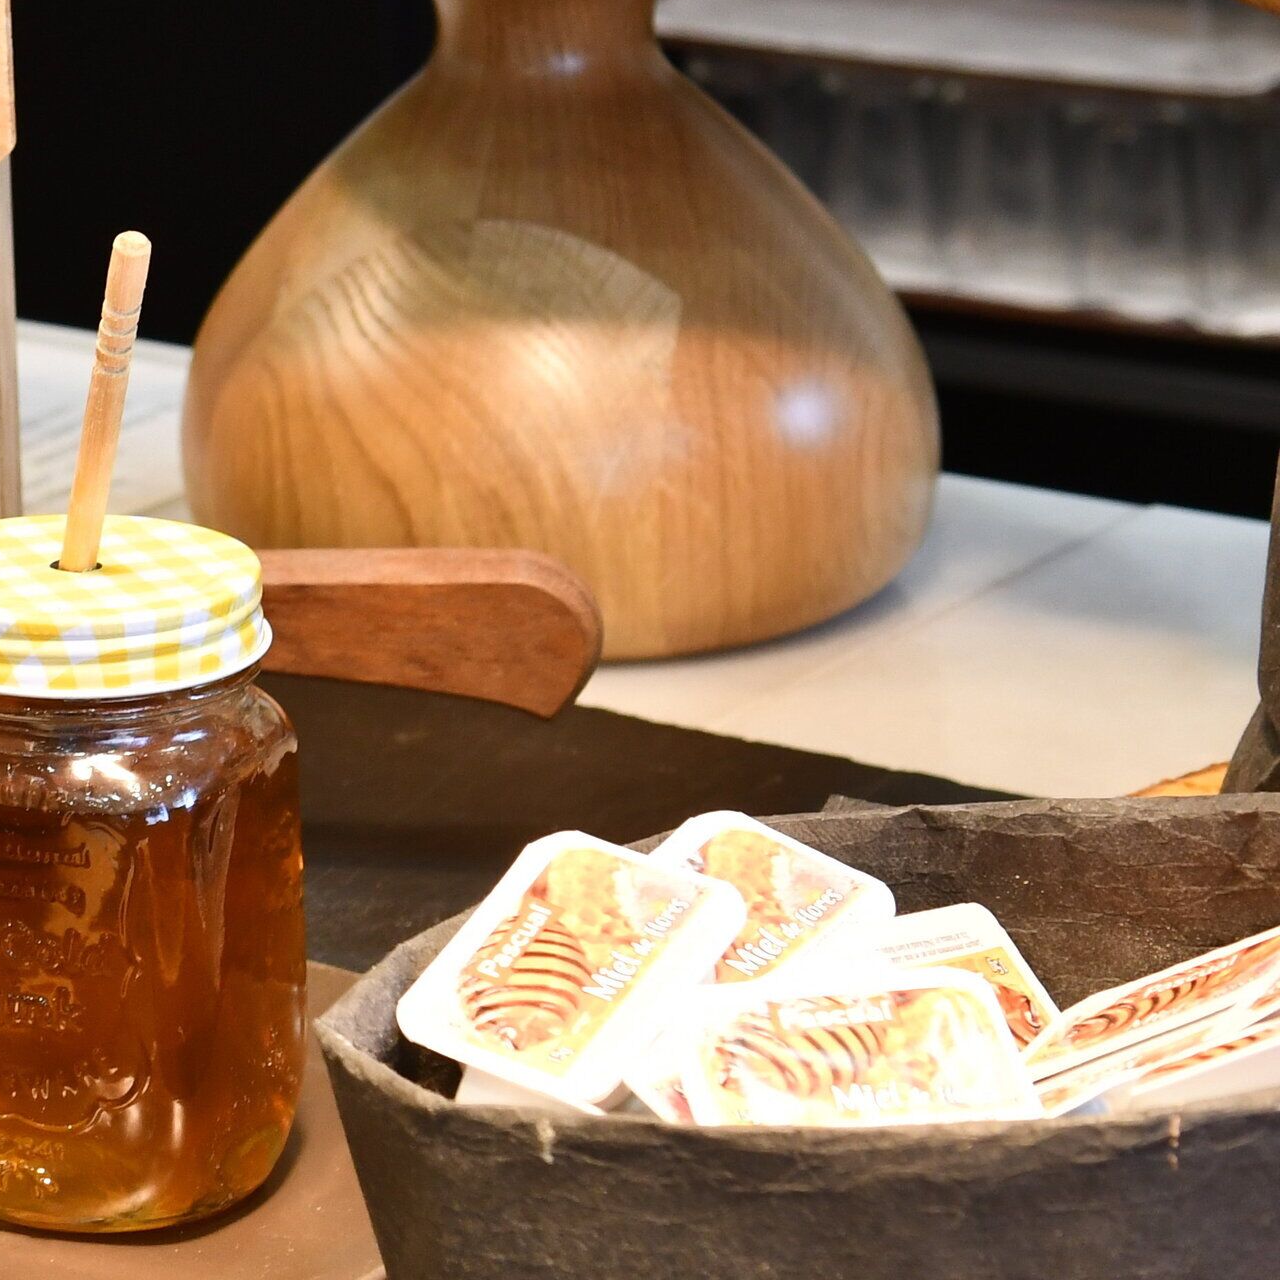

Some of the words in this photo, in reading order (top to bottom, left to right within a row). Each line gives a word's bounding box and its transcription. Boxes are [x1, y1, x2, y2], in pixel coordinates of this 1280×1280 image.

[476, 902, 553, 979] Pascual
[581, 950, 642, 1002] Miel
[641, 897, 691, 938] flores
[723, 926, 789, 977] Miel
[794, 888, 844, 928] flores
